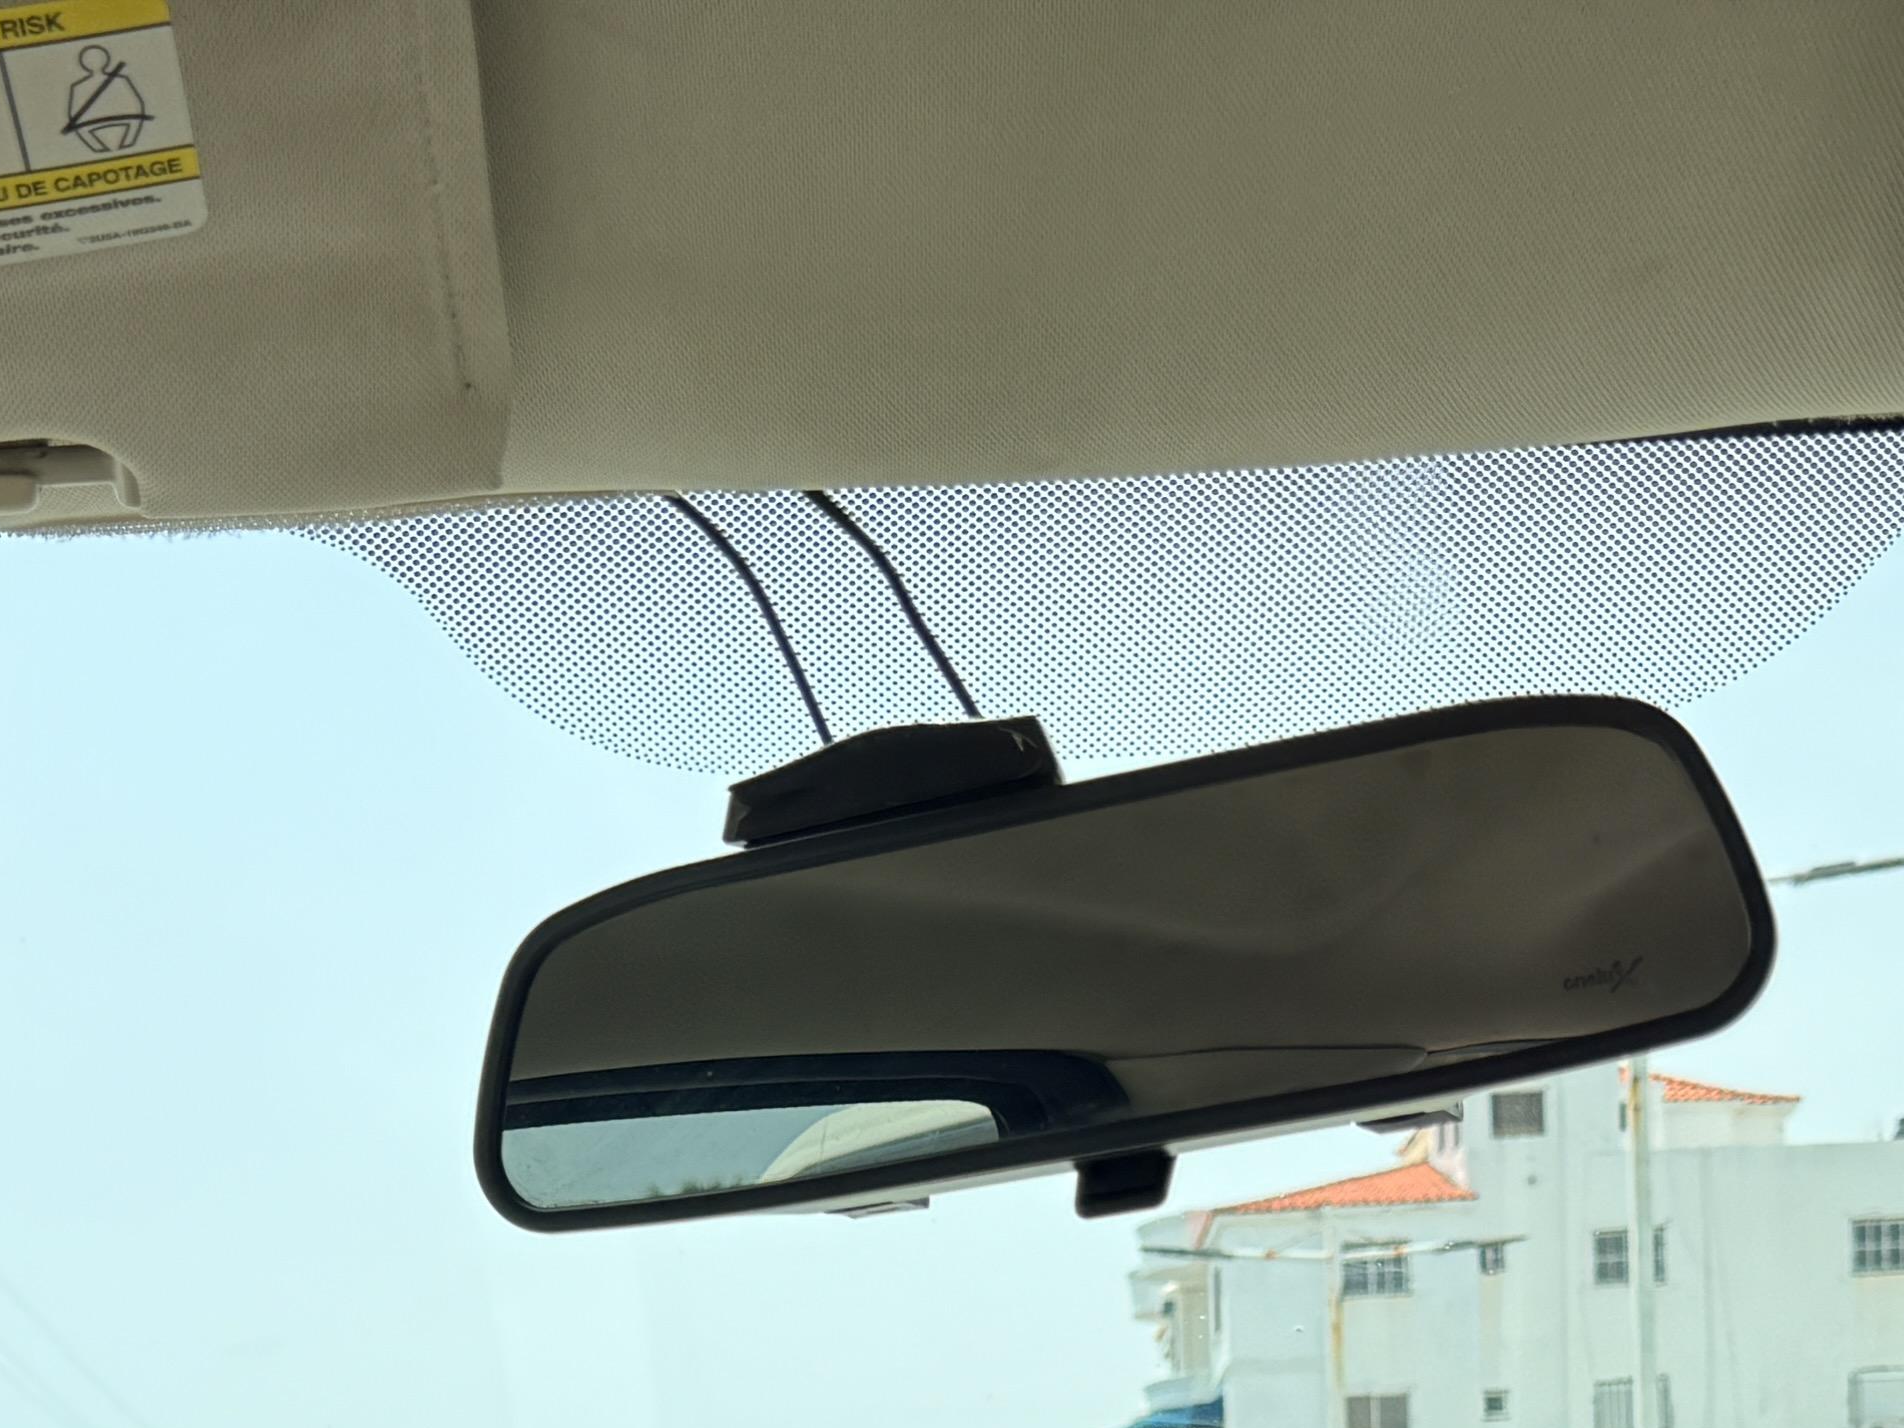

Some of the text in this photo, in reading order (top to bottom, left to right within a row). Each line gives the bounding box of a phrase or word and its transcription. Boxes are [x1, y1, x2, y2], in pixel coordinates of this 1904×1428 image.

[1, 11, 65, 38] RISK
[14, 180, 48, 199] DE
[53, 157, 183, 193] CAPOTAGE
